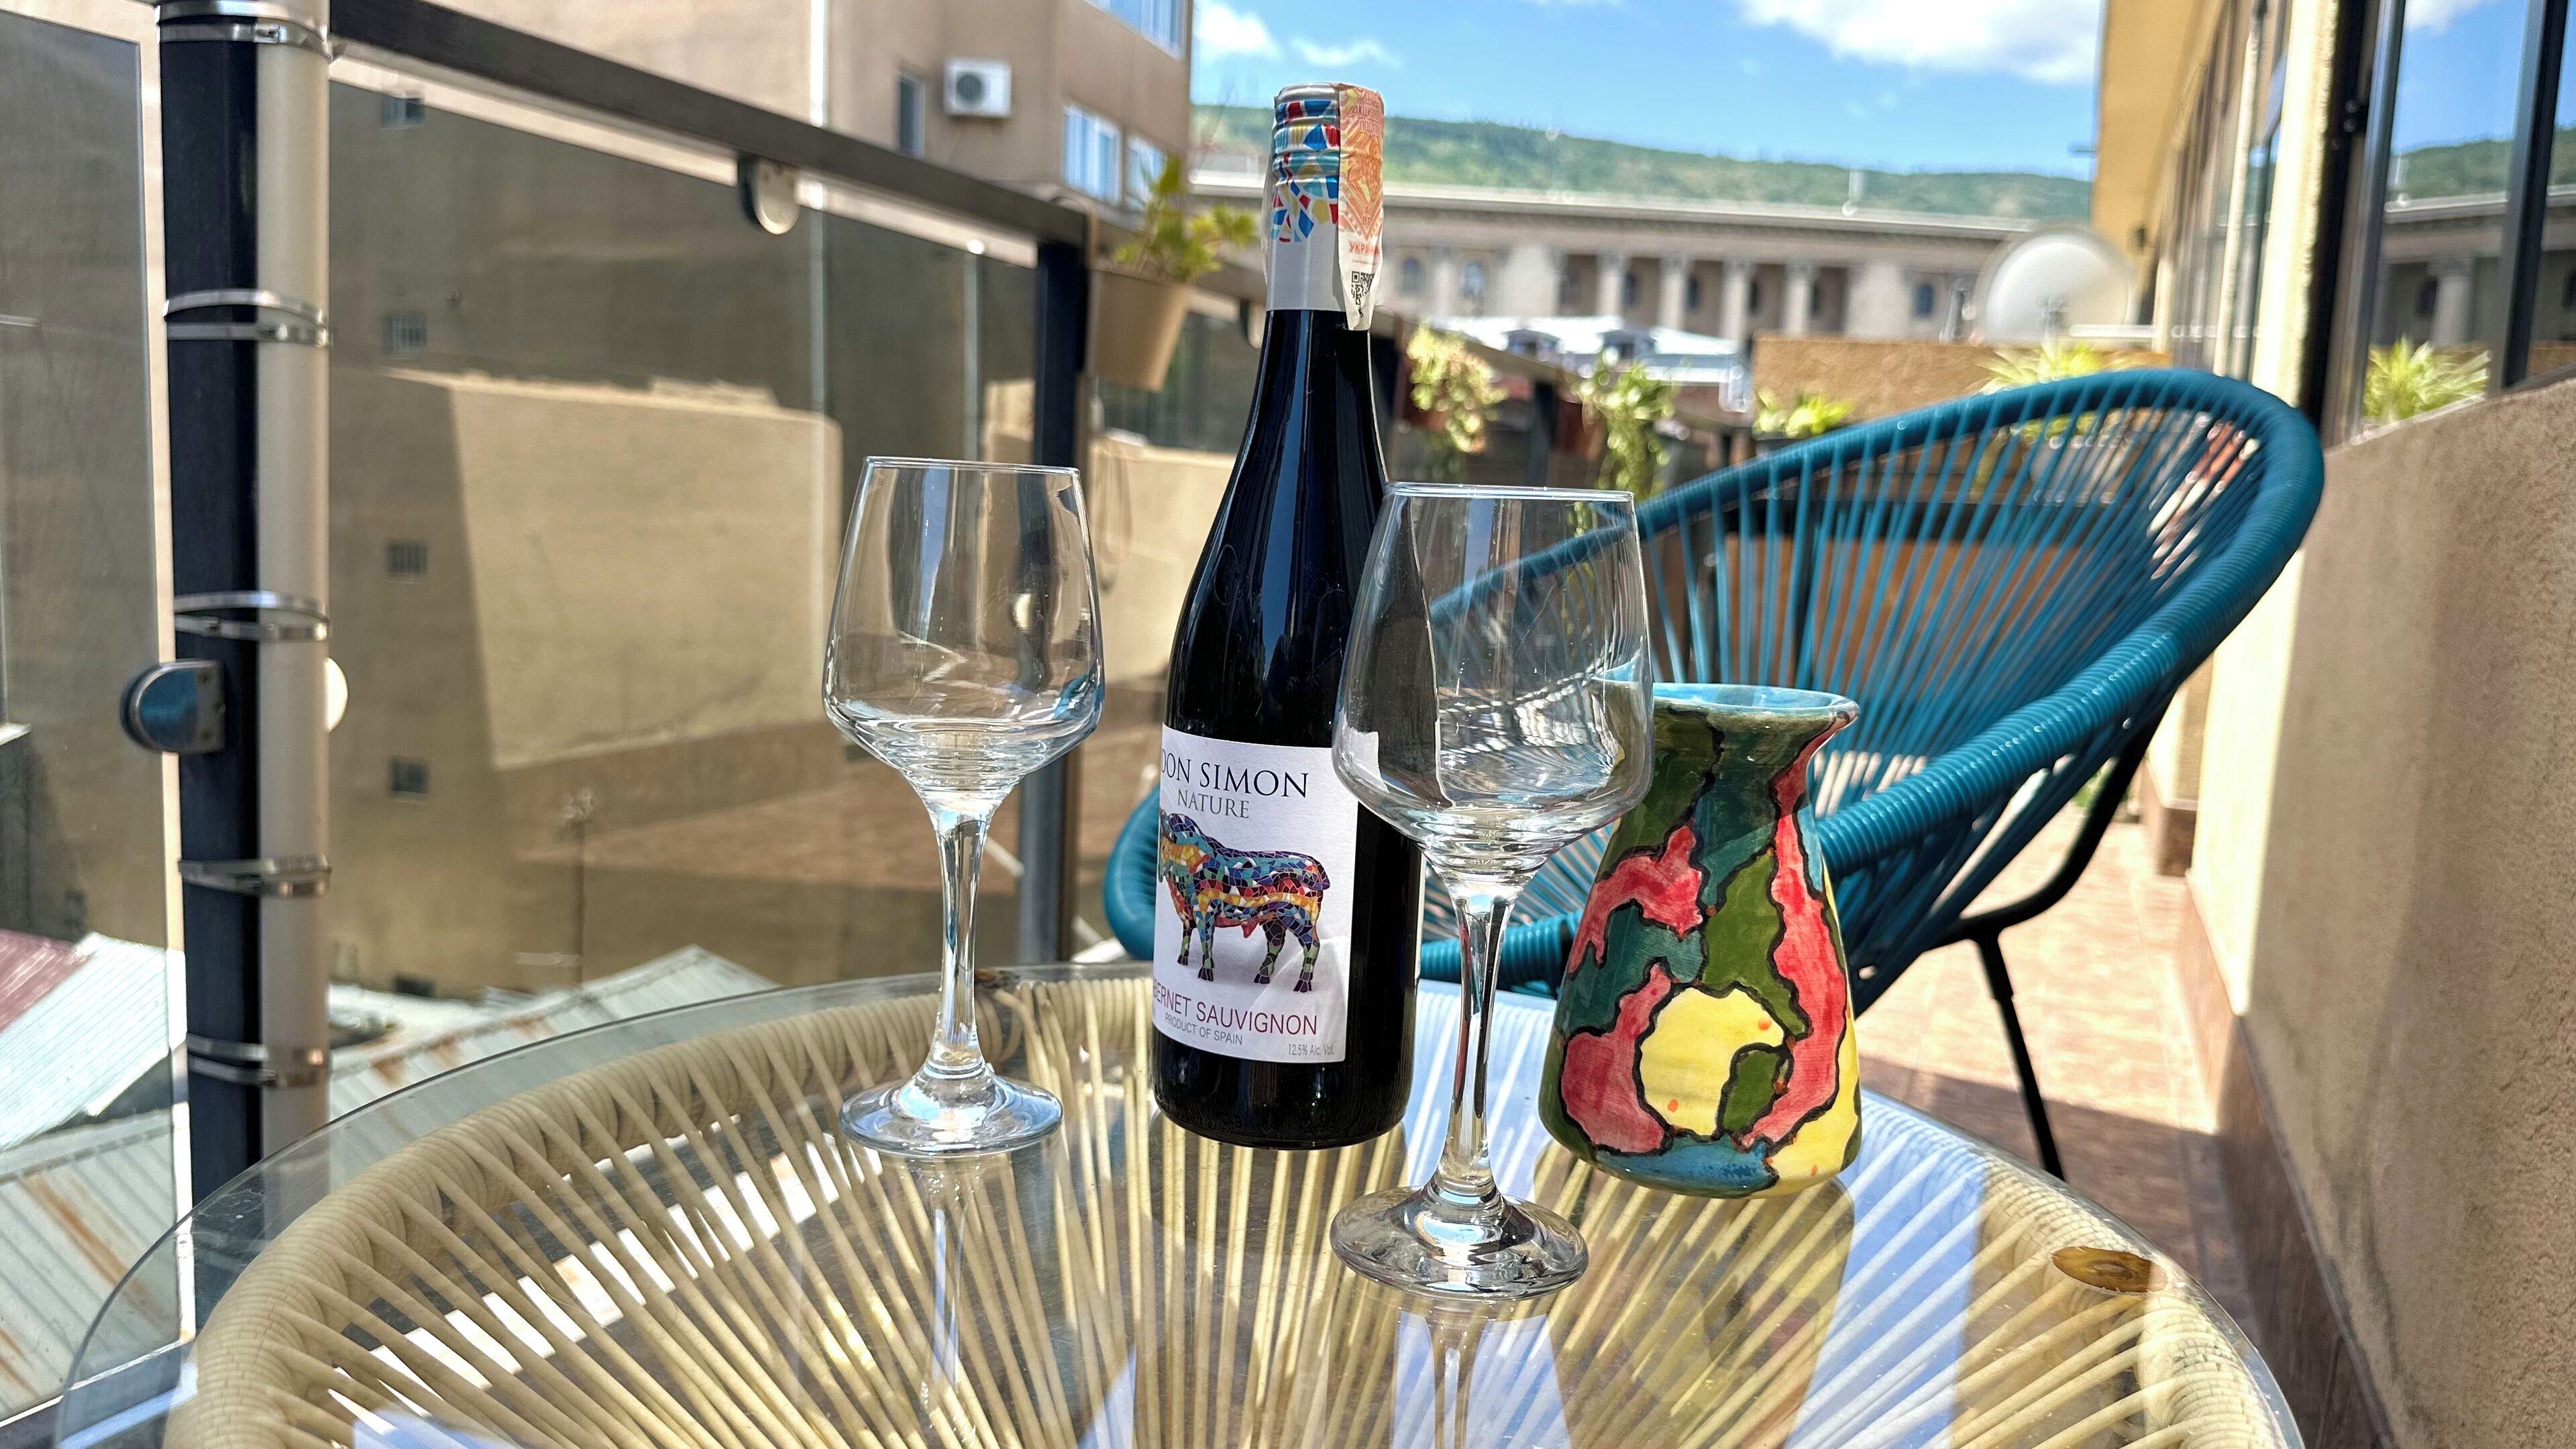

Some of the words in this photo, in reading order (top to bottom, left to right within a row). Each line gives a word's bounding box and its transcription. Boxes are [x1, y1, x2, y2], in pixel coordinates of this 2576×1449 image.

[1199, 762, 1309, 798] SIMON
[1178, 788, 1250, 818] NATURE
[1154, 979, 1191, 1017] BERNET
[1196, 1002, 1317, 1035] SAUVIGNON
[1165, 1012, 1197, 1034] PRODUCT
[1199, 1026, 1212, 1038] OF
[1214, 1030, 1242, 1045] SPAIN
[1289, 1044, 1308, 1055] 12.5%
[1309, 1044, 1321, 1055] Alc.
[1324, 1044, 1334, 1055] Vol.
